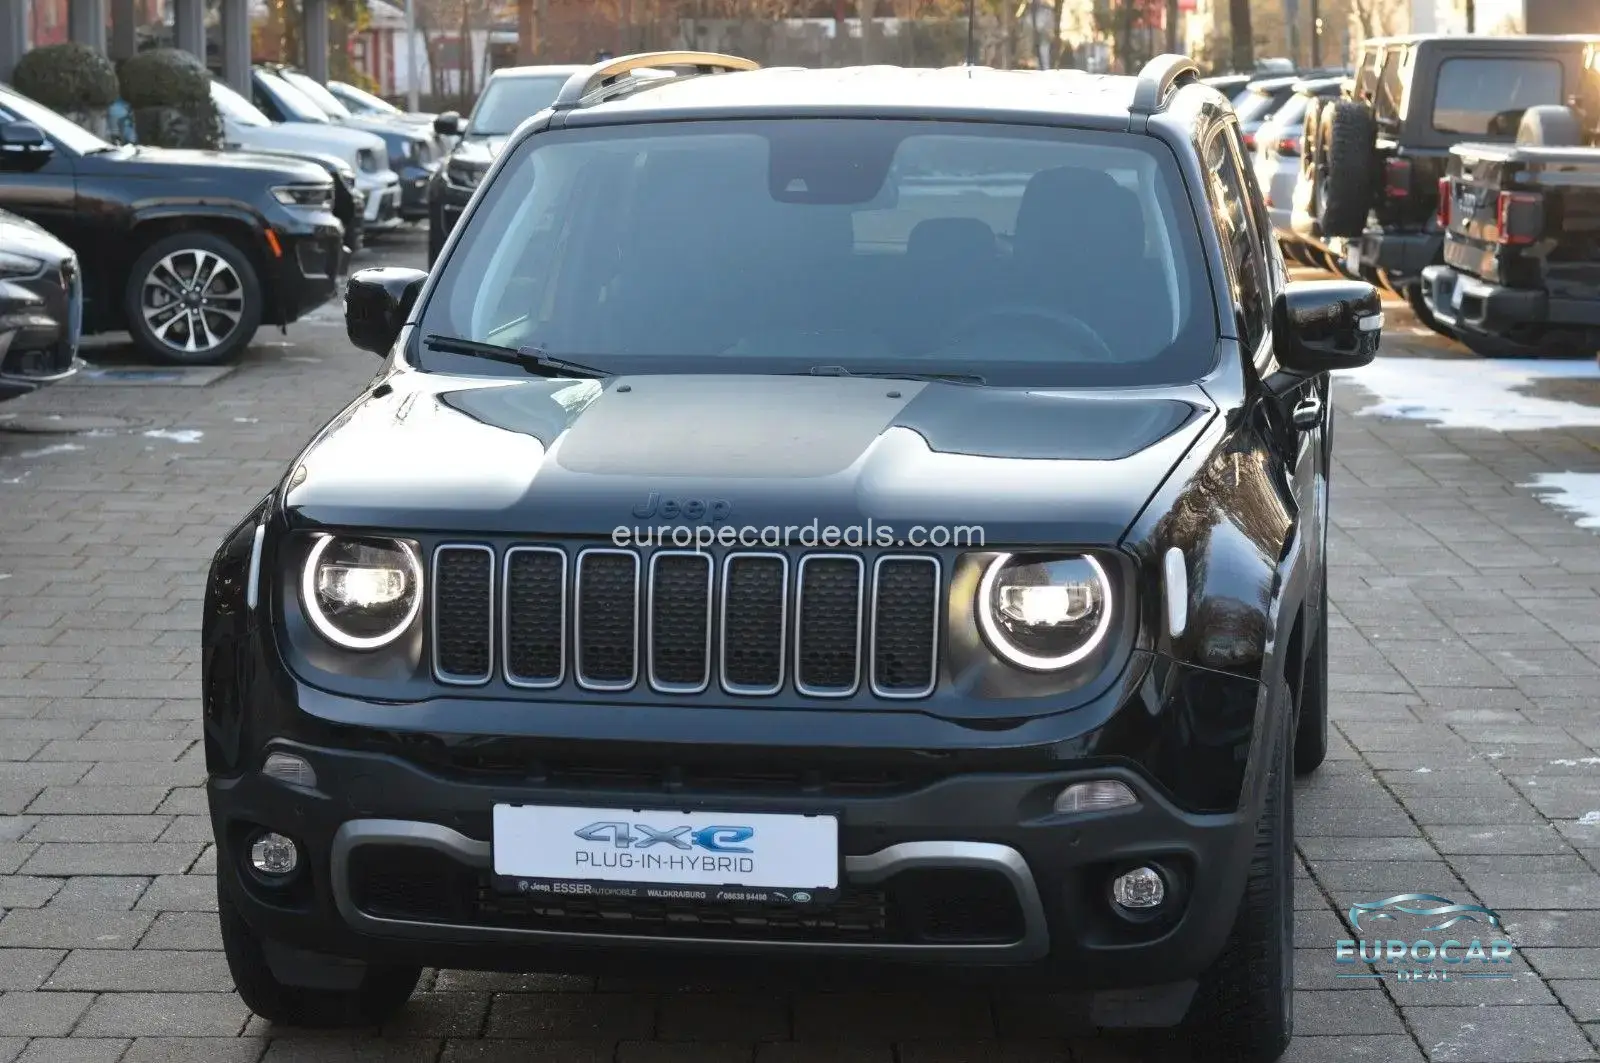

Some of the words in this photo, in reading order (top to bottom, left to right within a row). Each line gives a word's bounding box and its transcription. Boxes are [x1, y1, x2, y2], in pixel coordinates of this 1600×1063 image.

[632, 492, 731, 526] Jeep
[575, 850, 753, 873] PLUG-IN-HYBRID
[553, 883, 592, 894] ESSER
